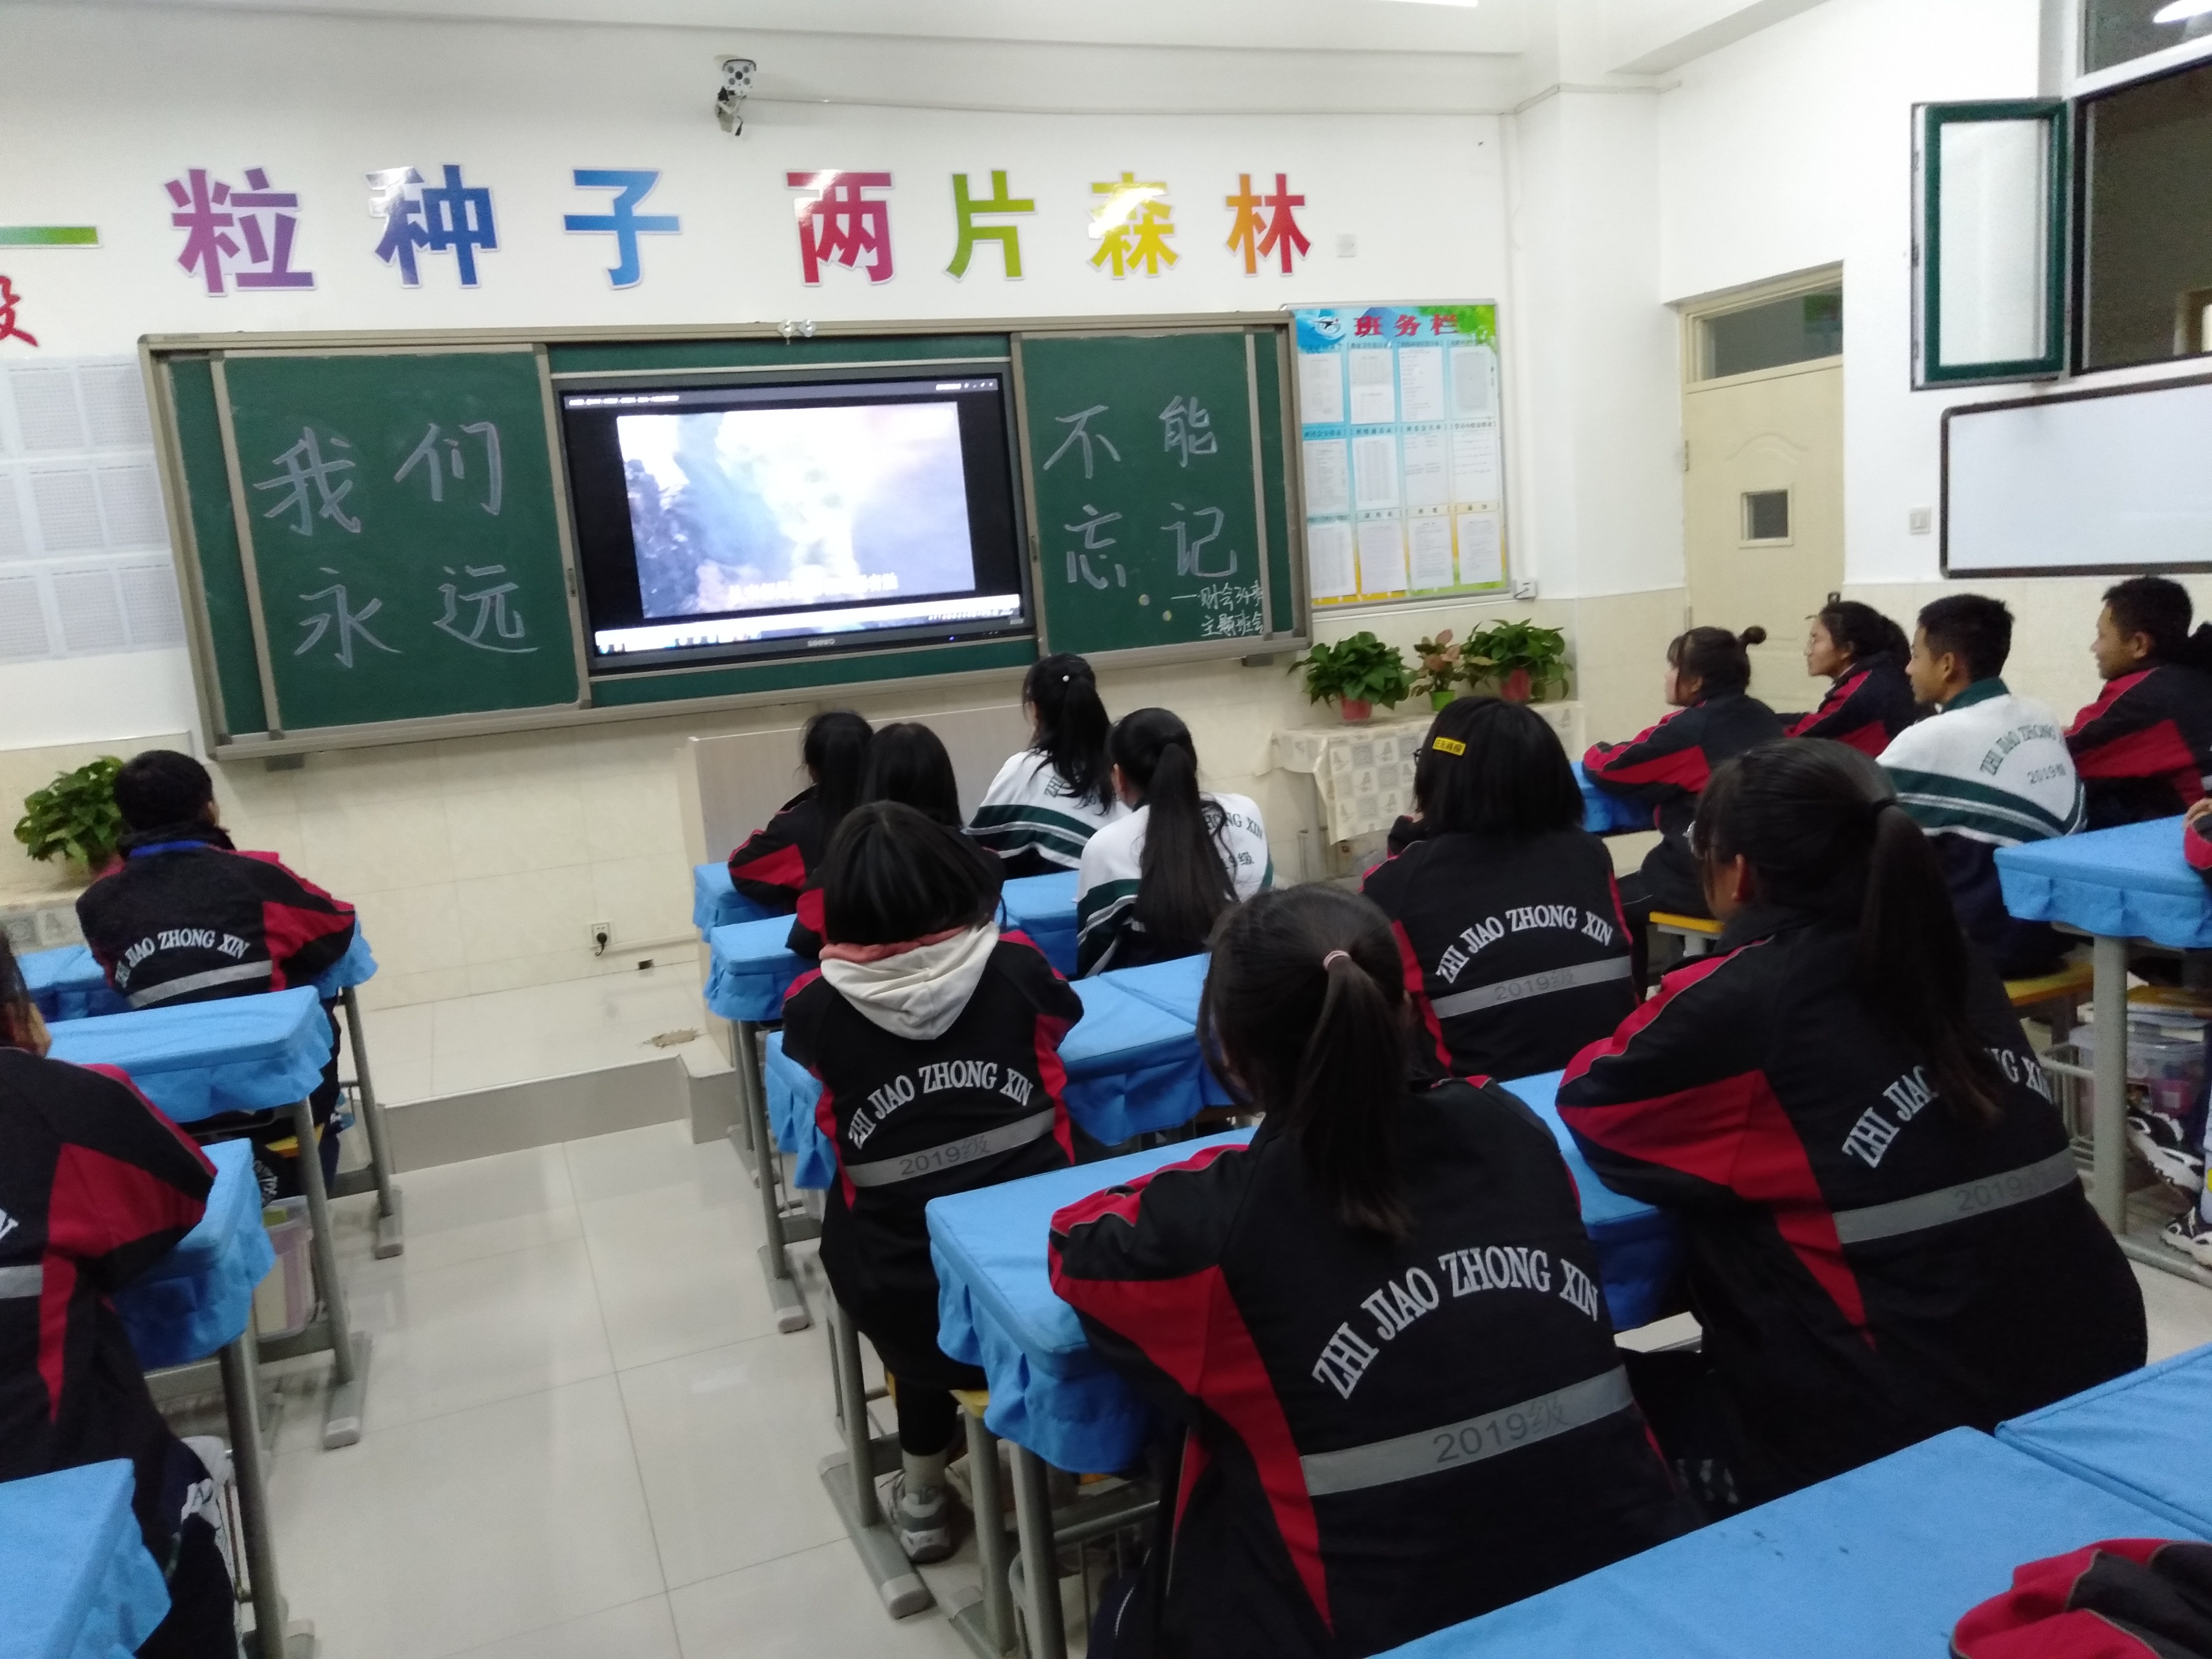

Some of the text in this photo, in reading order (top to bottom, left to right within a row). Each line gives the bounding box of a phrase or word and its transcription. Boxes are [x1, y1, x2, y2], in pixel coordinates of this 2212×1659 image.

[1354, 314, 1459, 338] 班务栏
[1043, 395, 1218, 479] 不能
[253, 421, 502, 537] 我们
[1065, 502, 1237, 590] 忘记
[294, 565, 540, 668] 永远
[1979, 748, 2004, 776] ZHI
[1246, 816, 1263, 840] XIN
[124, 936, 156, 968] JIAO
[157, 928, 215, 950] ZHONG
[216, 933, 250, 960] XIN
[1435, 904, 1614, 984] ZHI JIAO ZHONG XIN
[1494, 969, 1577, 1001] 2019级
[848, 1060, 1034, 1150] ZHI JIAO ZHONG XIN
[1841, 1106, 1900, 1168] ZHI
[900, 1135, 992, 1176] 2019级
[1311, 1245, 1598, 1400] ZHI JIAO ZHONG XIN
[1432, 1395, 1571, 1464] 2019级
